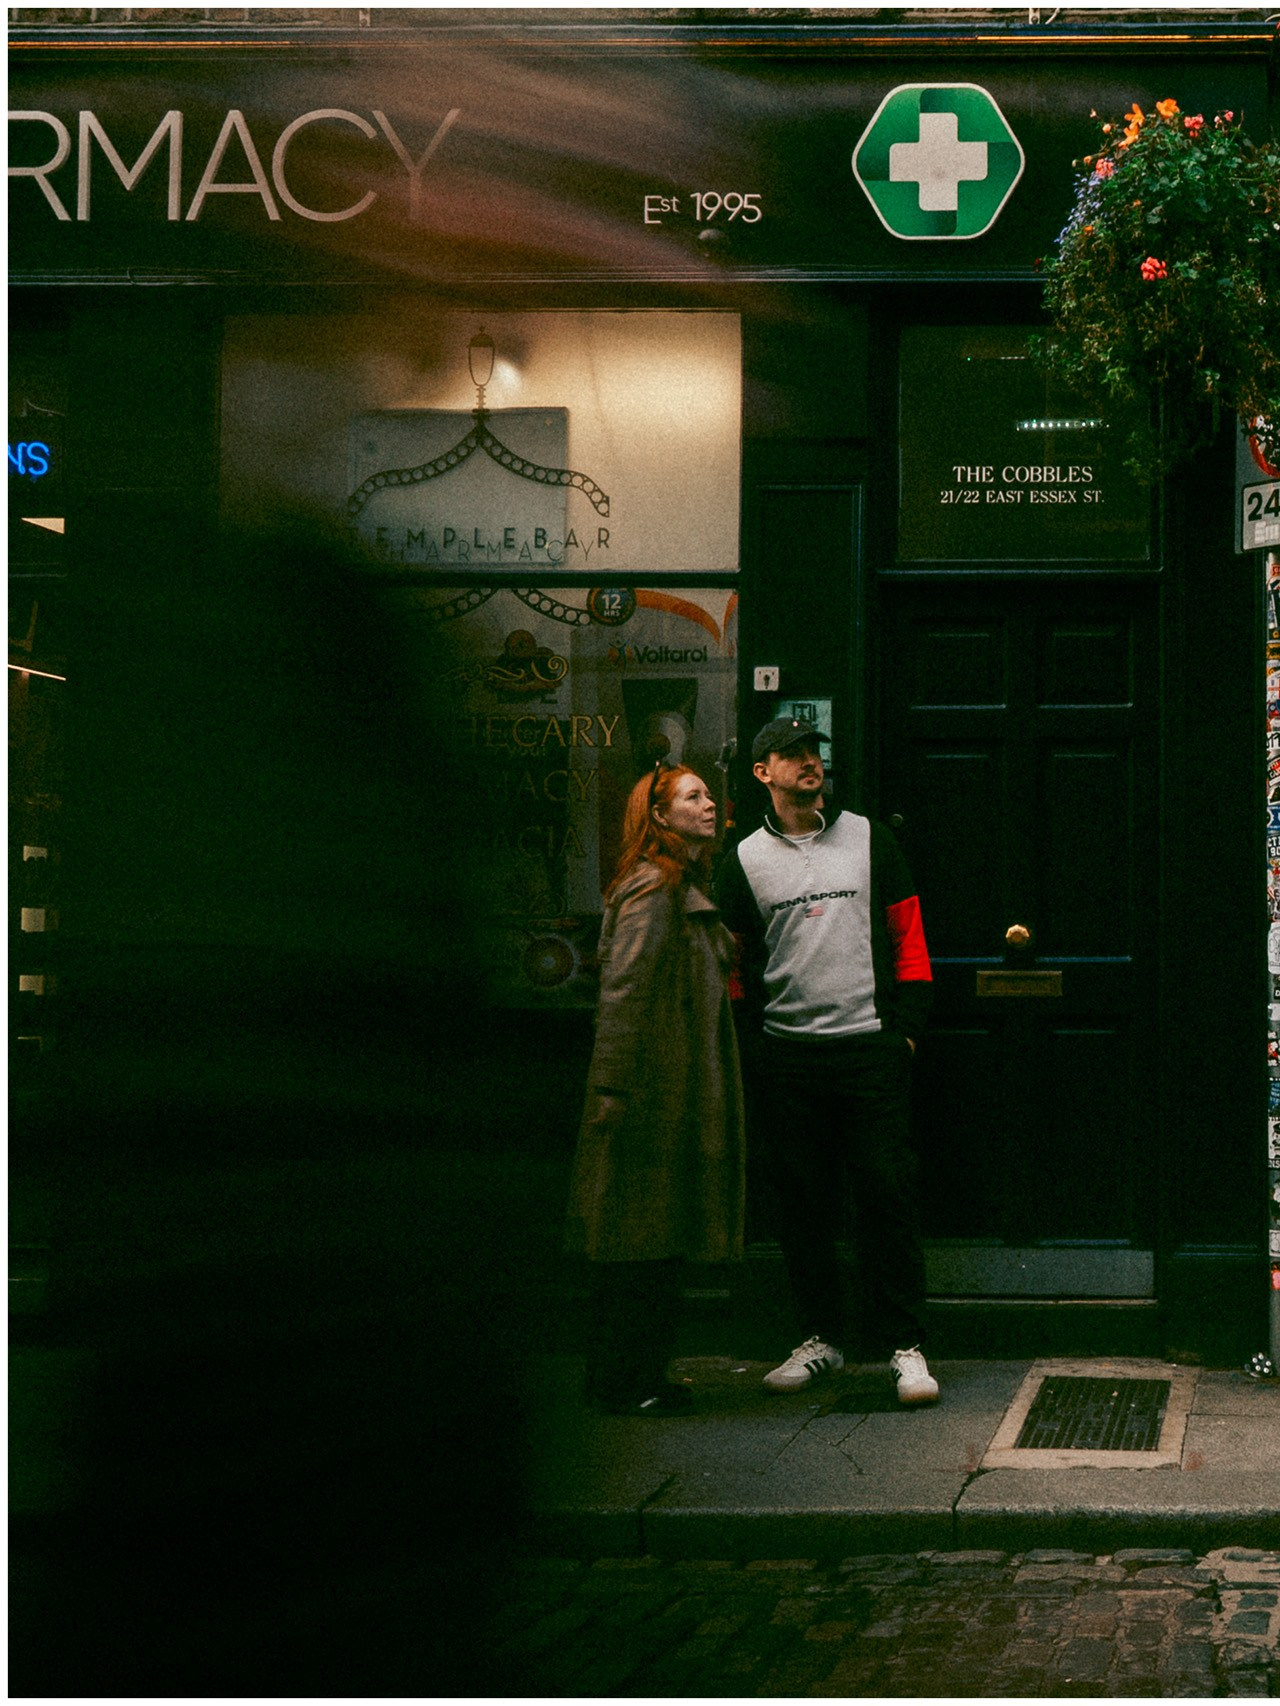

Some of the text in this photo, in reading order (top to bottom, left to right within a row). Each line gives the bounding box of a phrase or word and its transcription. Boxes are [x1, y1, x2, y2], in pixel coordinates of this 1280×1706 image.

[8, 109, 461, 220] RMACY
[644, 191, 762, 224] Est 1995
[953, 466, 1093, 483] THE COBBLES
[940, 490, 980, 503] 21/22
[986, 490, 1024, 503] EAST
[1030, 490, 1077, 503] ESSEX
[1247, 488, 1280, 522] 24
[602, 593, 622, 610] 12
[633, 644, 708, 662] Voltarol
[770, 890, 857, 913] PENN SPORT
